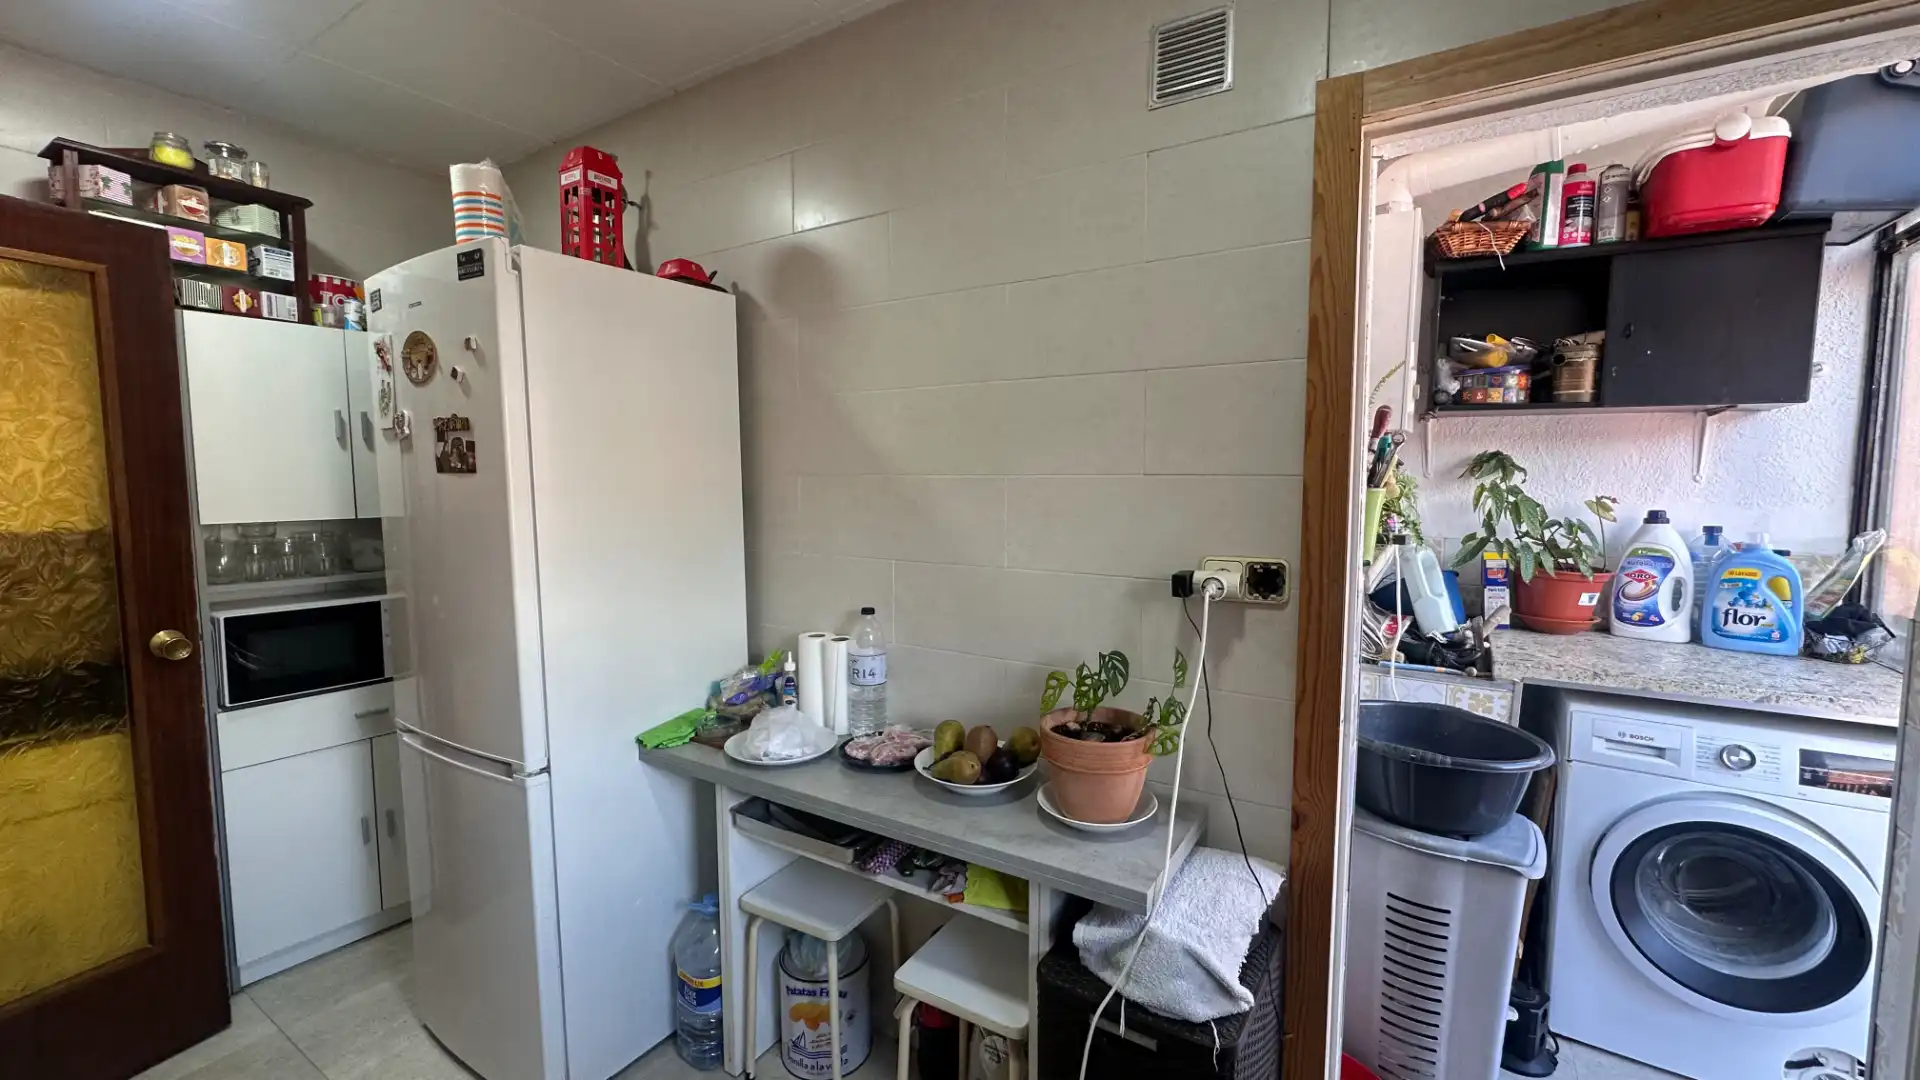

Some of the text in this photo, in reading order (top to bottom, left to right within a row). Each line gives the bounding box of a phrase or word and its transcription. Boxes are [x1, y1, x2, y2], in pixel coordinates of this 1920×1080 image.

[1629, 572, 1651, 580] ORO
[1721, 607, 1767, 627] flor
[1629, 733, 1654, 742] BOSCH
